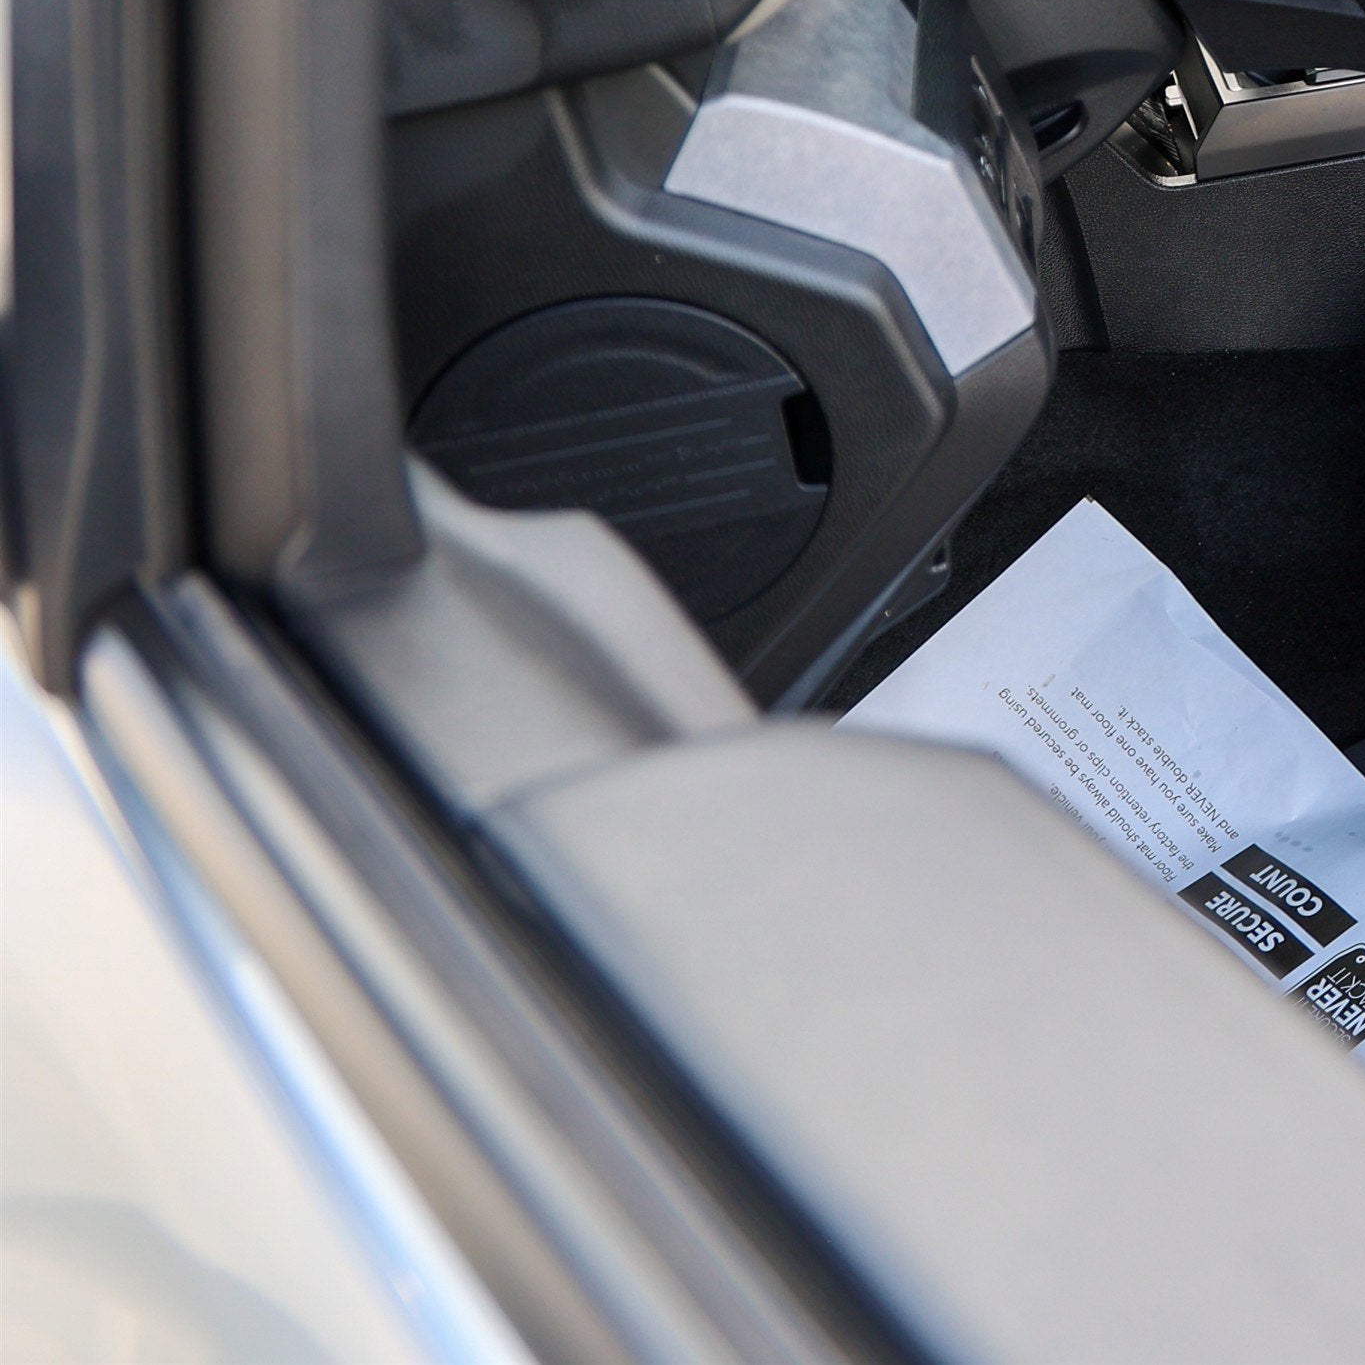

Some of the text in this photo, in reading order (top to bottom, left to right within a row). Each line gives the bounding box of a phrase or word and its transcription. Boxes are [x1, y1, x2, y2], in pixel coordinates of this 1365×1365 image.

[999, 688, 1027, 718] using
[1023, 717, 1066, 759] secured
[1026, 685, 1195, 870] the factory retention clips or grommets.
[1065, 758, 1080, 776] be
[1070, 686, 1222, 853] Make sure you have one floor mat
[1116, 704, 1239, 841] and NEVER double stack it.
[1078, 773, 1110, 806] always
[1106, 808, 1140, 842] should
[1137, 841, 1156, 861] mat
[1154, 860, 1178, 883] Floor
[1249, 864, 1323, 917] COUNT
[1205, 891, 1285, 953] SECURE
[1327, 967, 1351, 986] IT
